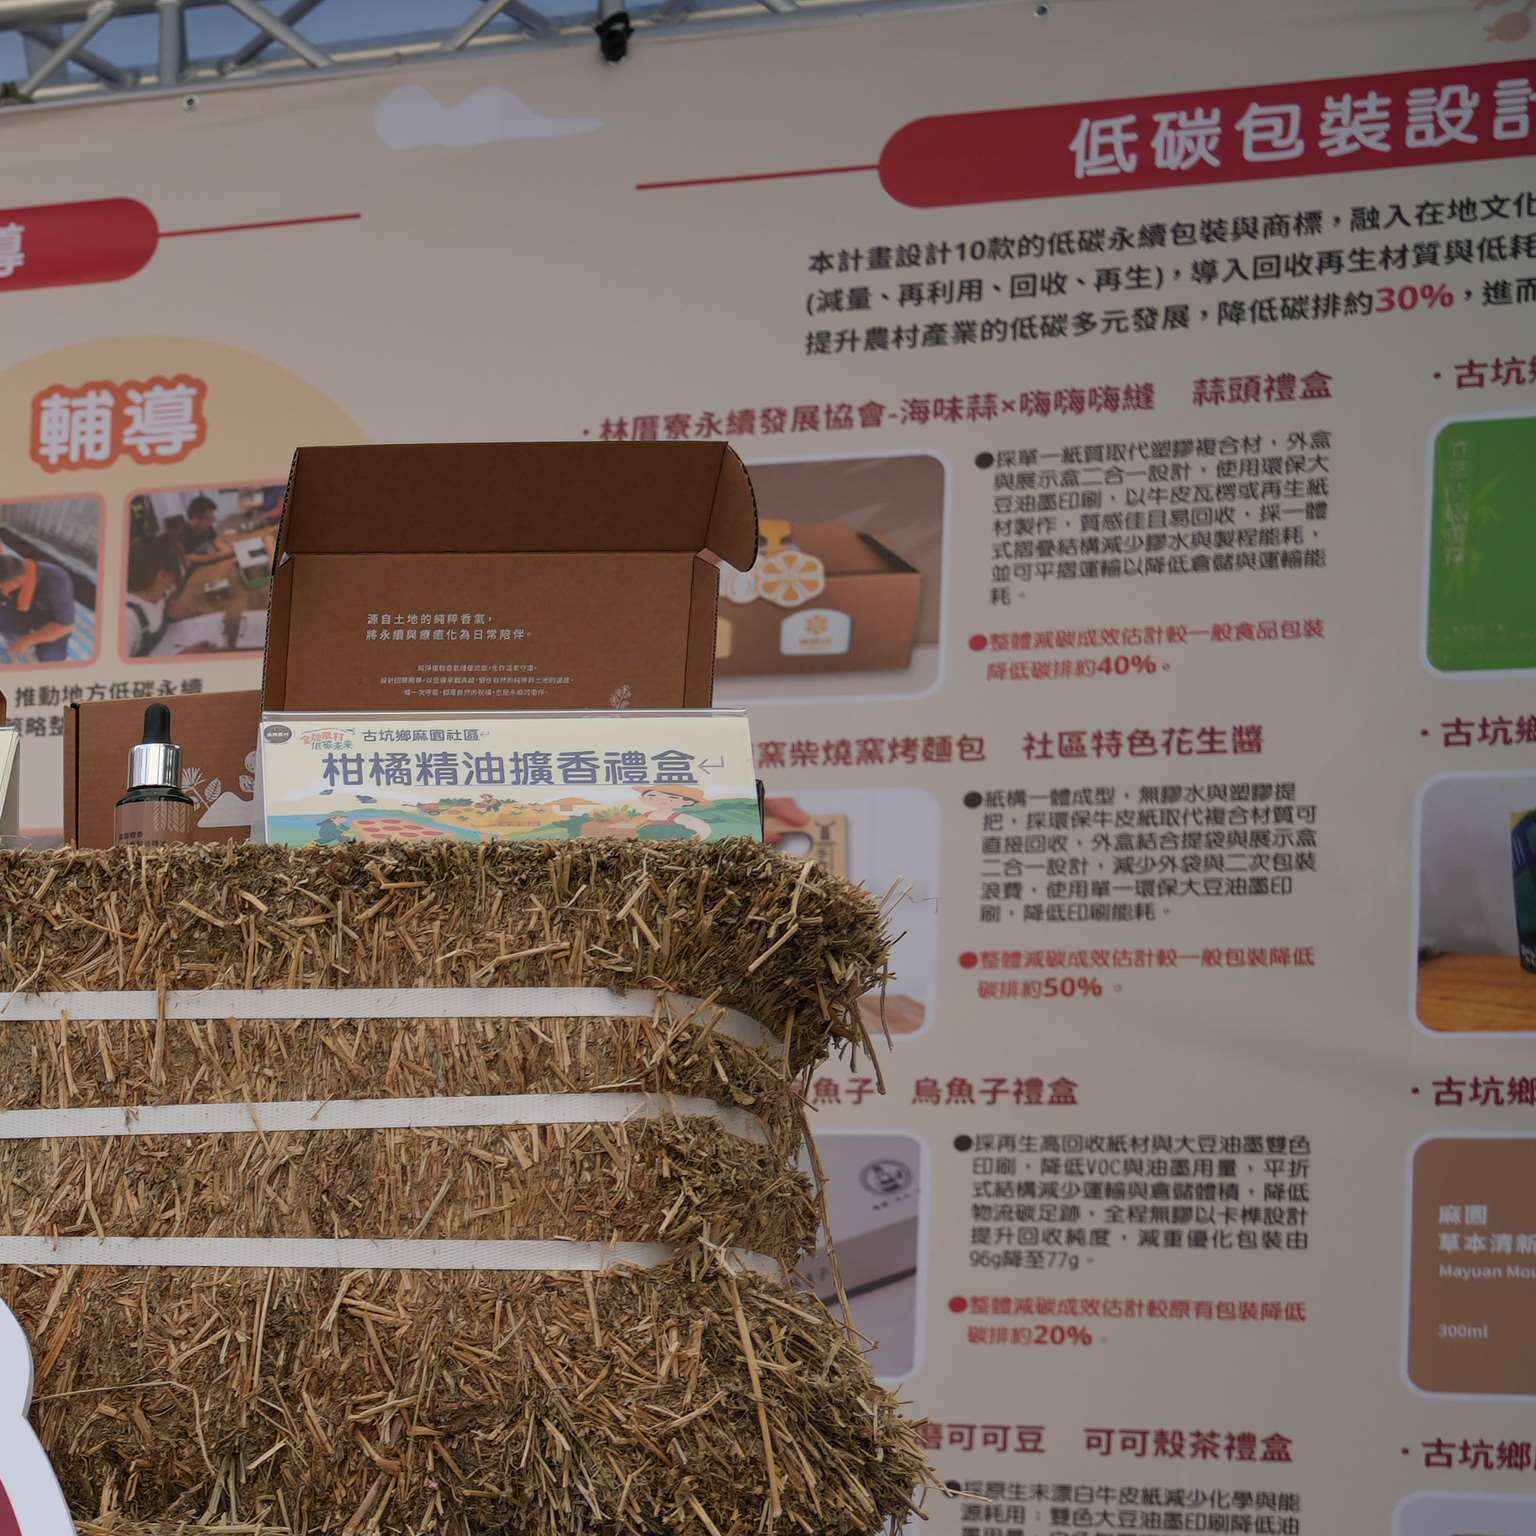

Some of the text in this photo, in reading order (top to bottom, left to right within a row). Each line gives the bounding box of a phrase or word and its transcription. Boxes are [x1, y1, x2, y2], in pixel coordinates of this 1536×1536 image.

[1069, 77, 1536, 180] 低碳包裝設計
[1194, 368, 1333, 408] 蒜頭禮盒
[39, 383, 199, 461] 輔導
[363, 728, 479, 742] 古坑鄉麻園社區
[1022, 724, 1265, 761] 社區特色花生醬
[322, 751, 698, 787] 柑橘精油擴香禮盒
[791, 1076, 1079, 1107] 魚子 烏魚子禮盒
[1438, 1263, 1501, 1281] Mayuan
[1438, 1323, 1488, 1338] 300ml
[1084, 1426, 1293, 1463] 可可殼茶禮盒
[1422, 1438, 1536, 1472] 古坑鄉
